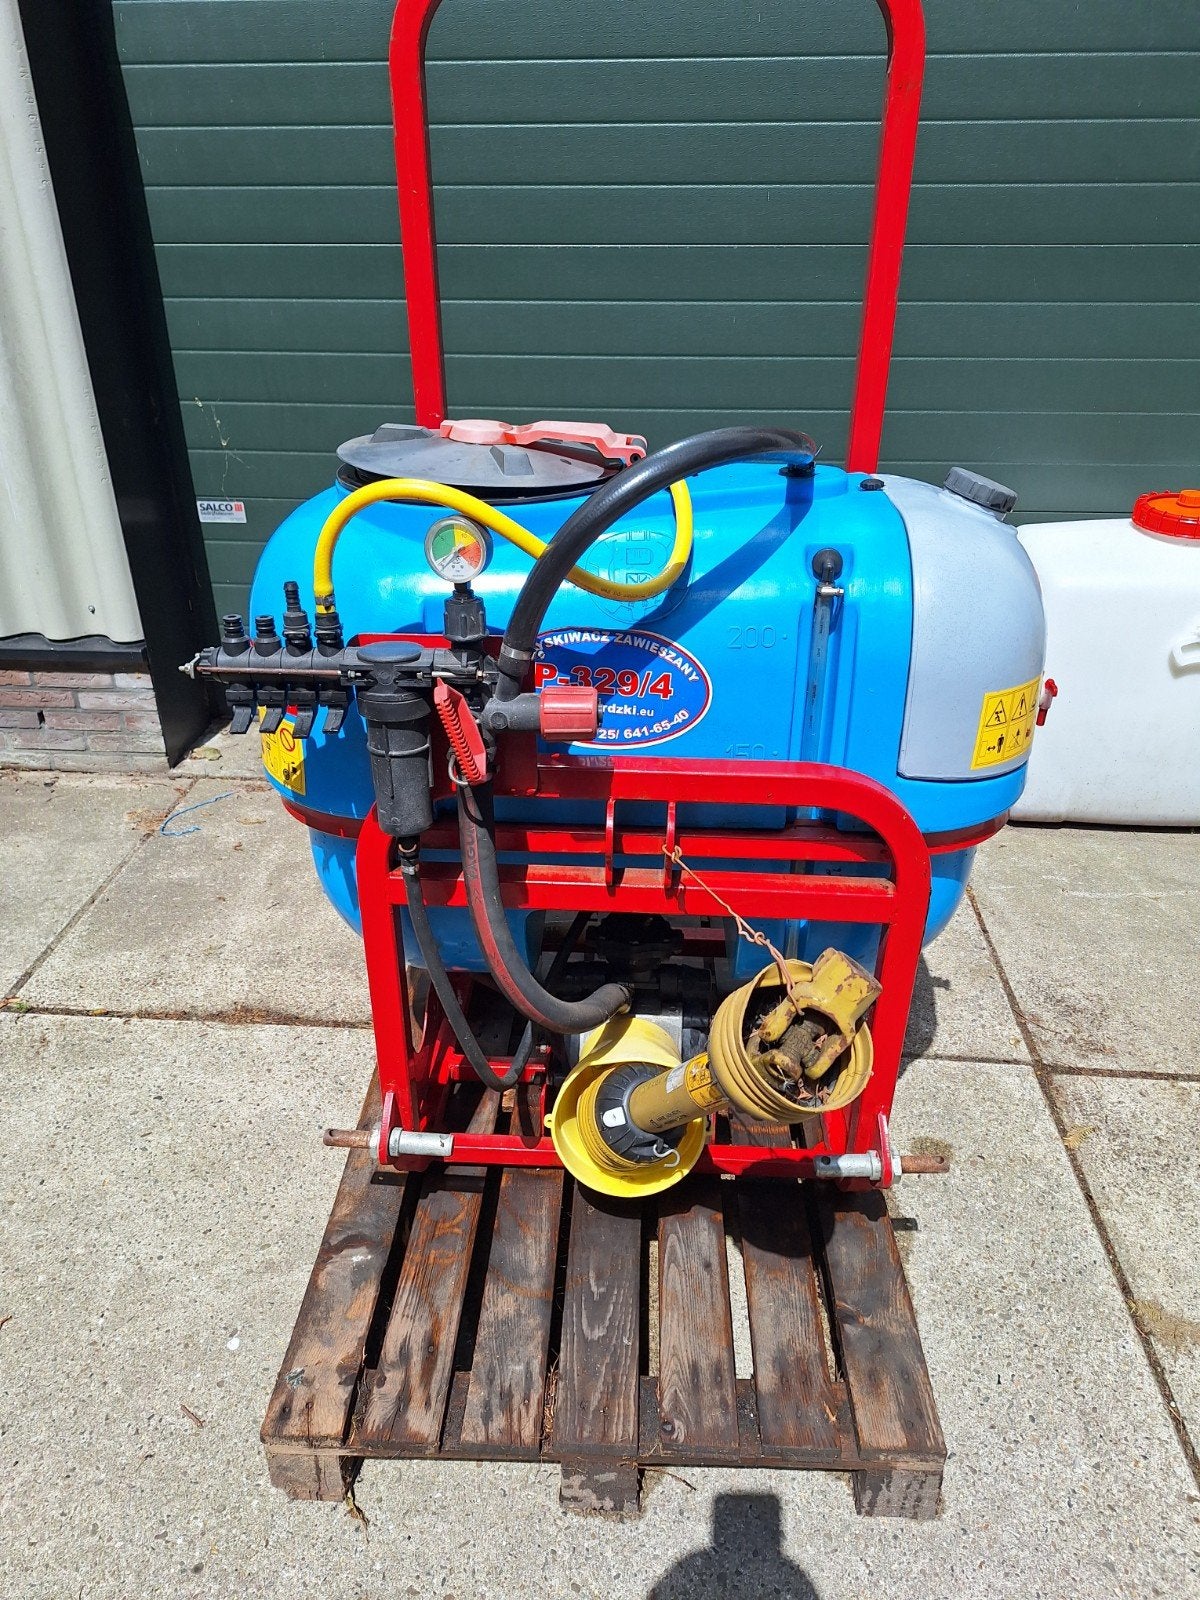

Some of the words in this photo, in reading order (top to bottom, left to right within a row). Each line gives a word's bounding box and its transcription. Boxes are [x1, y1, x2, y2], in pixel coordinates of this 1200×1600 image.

[199, 503, 233, 511] SALCO
[727, 625, 776, 650] 200
[534, 631, 610, 651] YSKIWACZ
[613, 632, 700, 682] ZAWIESZANY
[602, 703, 655, 717] rdzki.eu
[623, 708, 690, 740] 641-65-40
